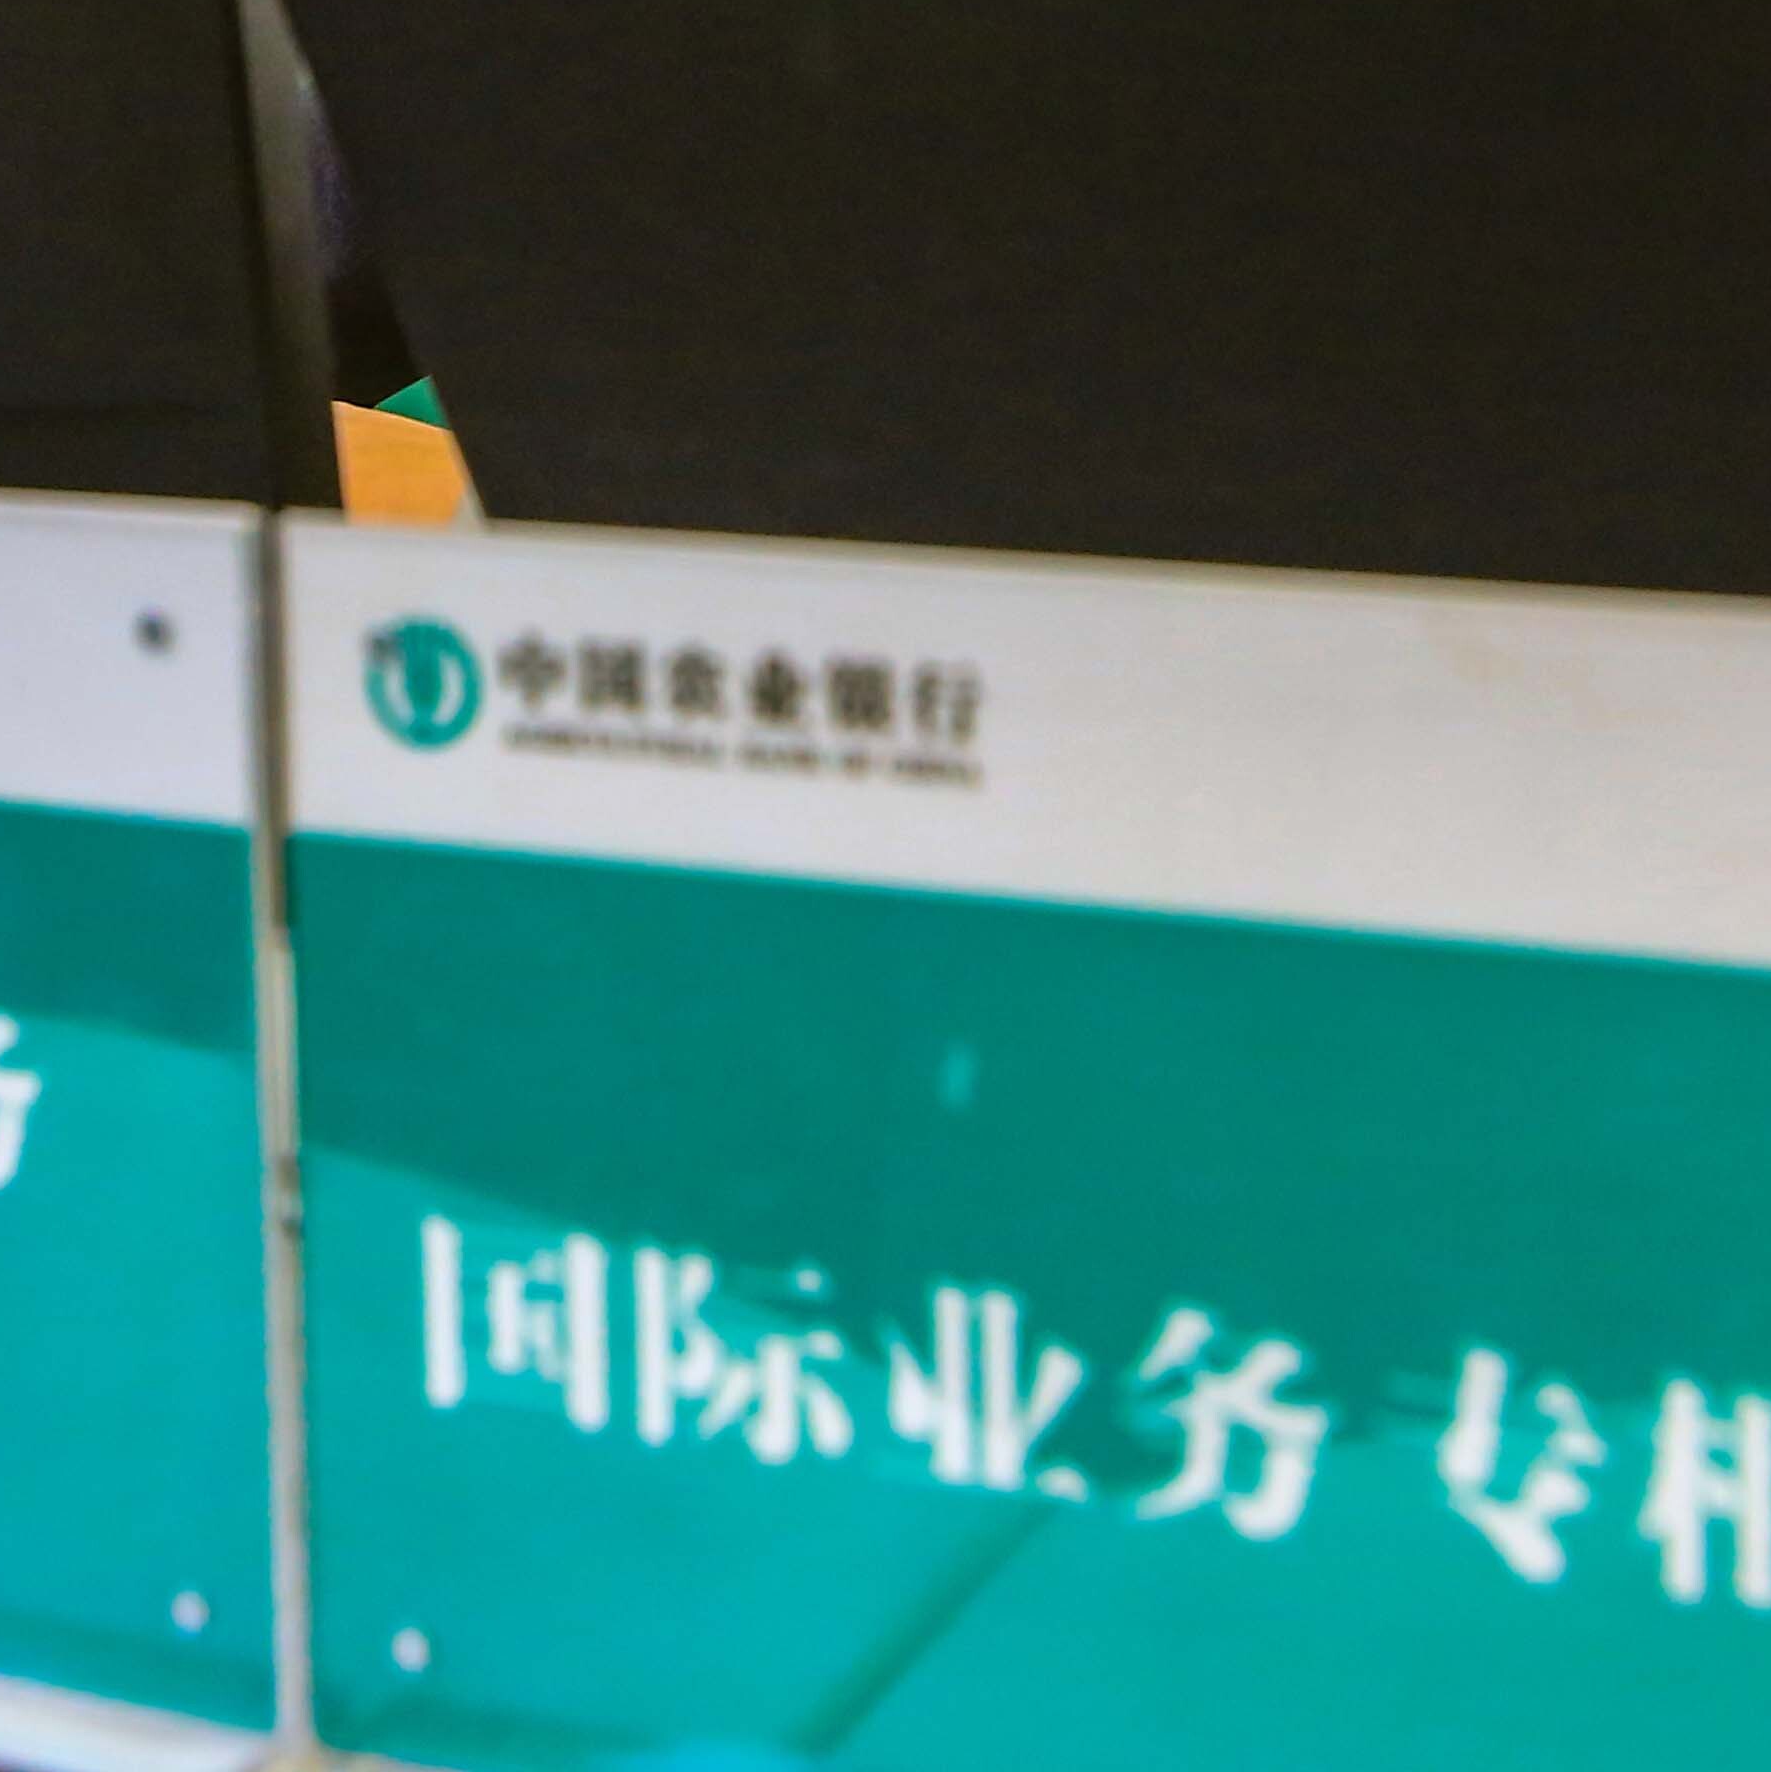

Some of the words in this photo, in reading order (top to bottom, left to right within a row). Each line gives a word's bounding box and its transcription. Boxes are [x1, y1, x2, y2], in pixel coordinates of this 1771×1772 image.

[496, 626, 983, 748] 中国农业银行
